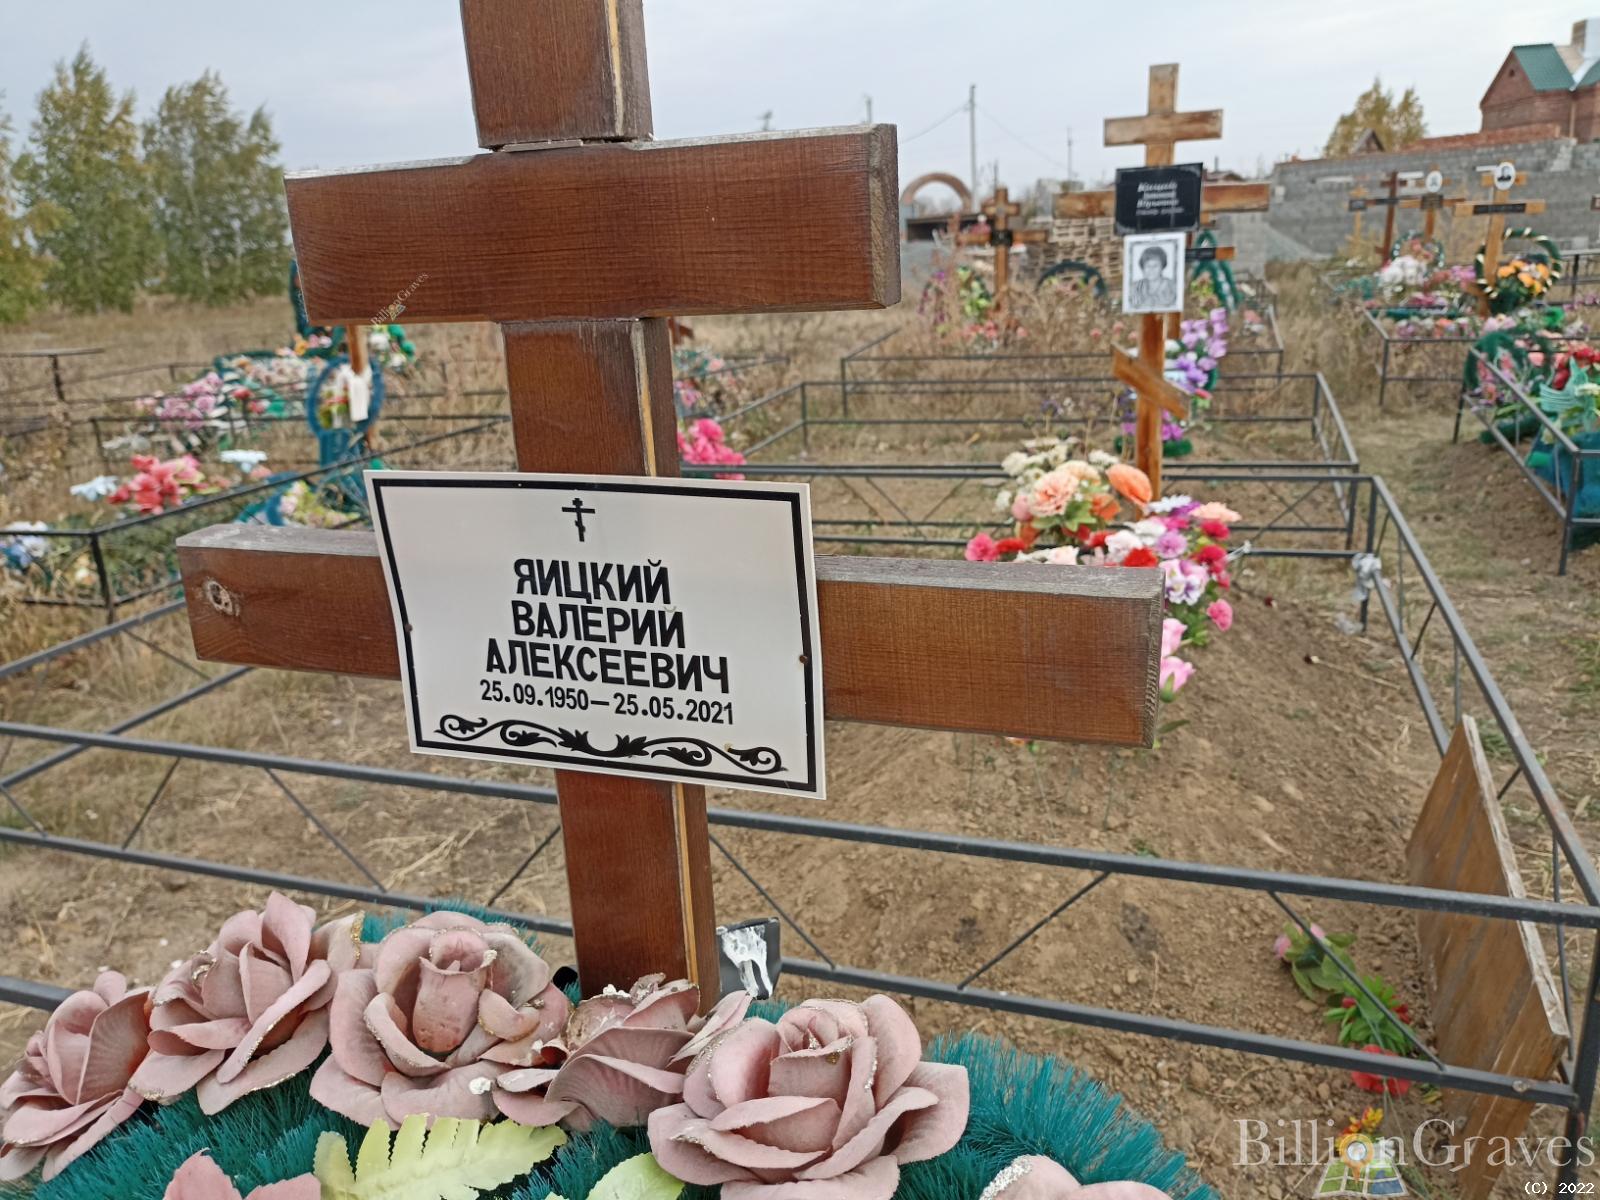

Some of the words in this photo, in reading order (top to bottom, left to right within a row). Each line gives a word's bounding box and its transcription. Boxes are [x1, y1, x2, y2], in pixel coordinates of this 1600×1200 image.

[513, 558, 671, 605] ЯИЦКИЙ
[511, 600, 686, 649] ВАЛЕРИЙ
[486, 638, 730, 694] АЛЕКСЕЕВИЧ
